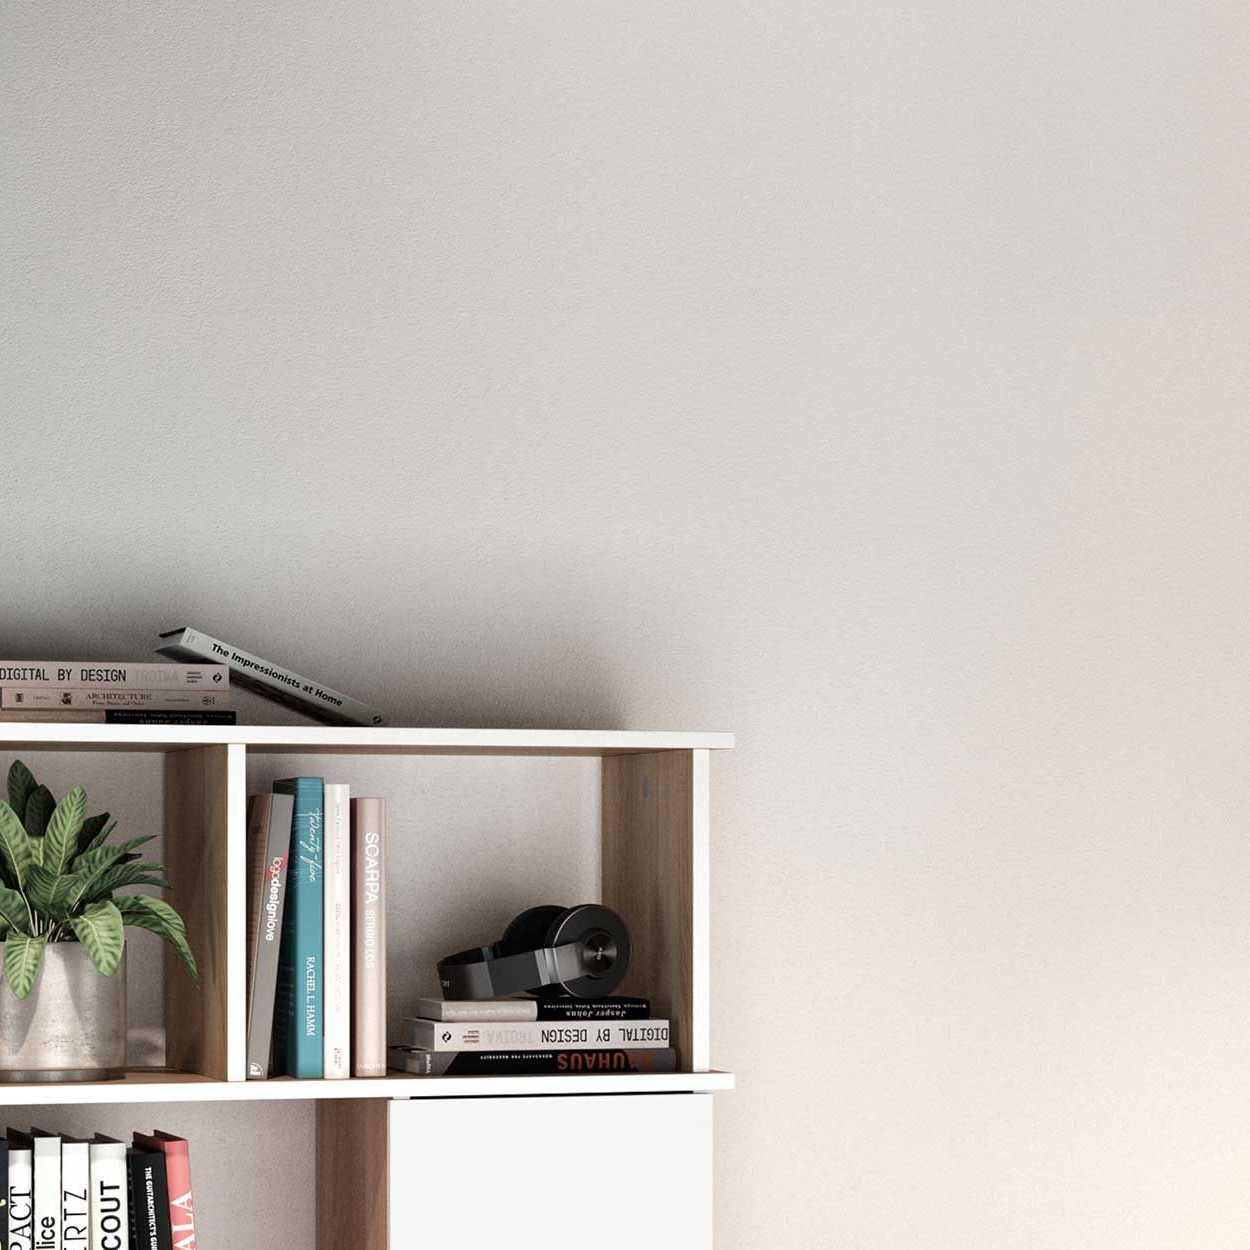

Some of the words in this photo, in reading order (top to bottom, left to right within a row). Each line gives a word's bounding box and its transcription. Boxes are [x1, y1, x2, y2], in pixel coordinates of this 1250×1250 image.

[0, 668, 49, 681] DIGITAL
[58, 669, 72, 681] BY
[81, 669, 126, 682] DESIGN
[212, 643, 229, 658] The
[231, 652, 301, 689] Impressionists
[302, 684, 314, 694] at
[314, 686, 343, 707] Home
[365, 832, 380, 905] SCARPA
[265, 856, 284, 942] logodesignlove
[365, 910, 376, 946] SERGIO
[365, 949, 376, 969] LOS
[306, 1005, 315, 1036] HAMM
[566, 1010, 590, 1018] Johns
[592, 1010, 626, 1019] Jasper
[541, 1029, 587, 1042] DESIGN
[596, 1029, 611, 1041] BY
[618, 1028, 669, 1041] DIGITAL
